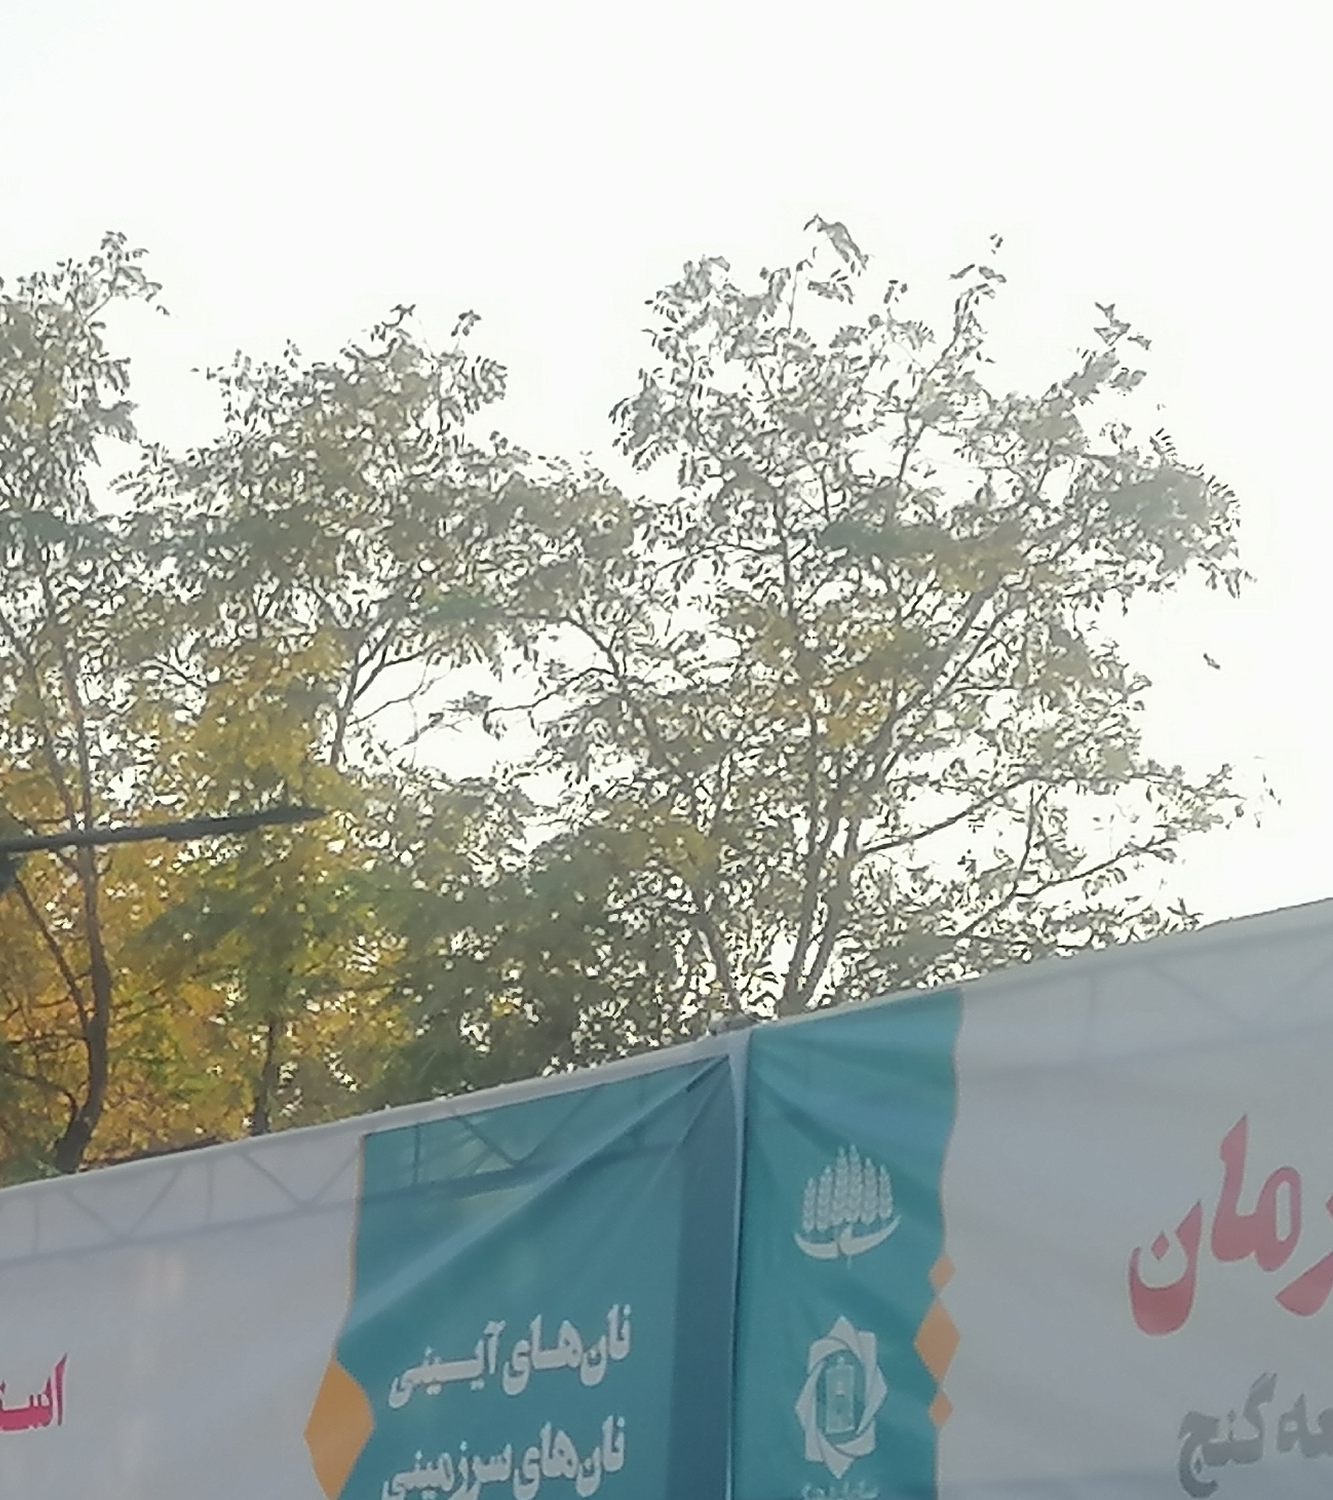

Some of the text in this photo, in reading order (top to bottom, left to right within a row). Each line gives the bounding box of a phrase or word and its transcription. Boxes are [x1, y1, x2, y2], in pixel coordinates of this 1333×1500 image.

[1128, 1113, 1333, 1337] رمان
[388, 1319, 506, 1409] آیینی
[1177, 1371, 1279, 1500] گنج
